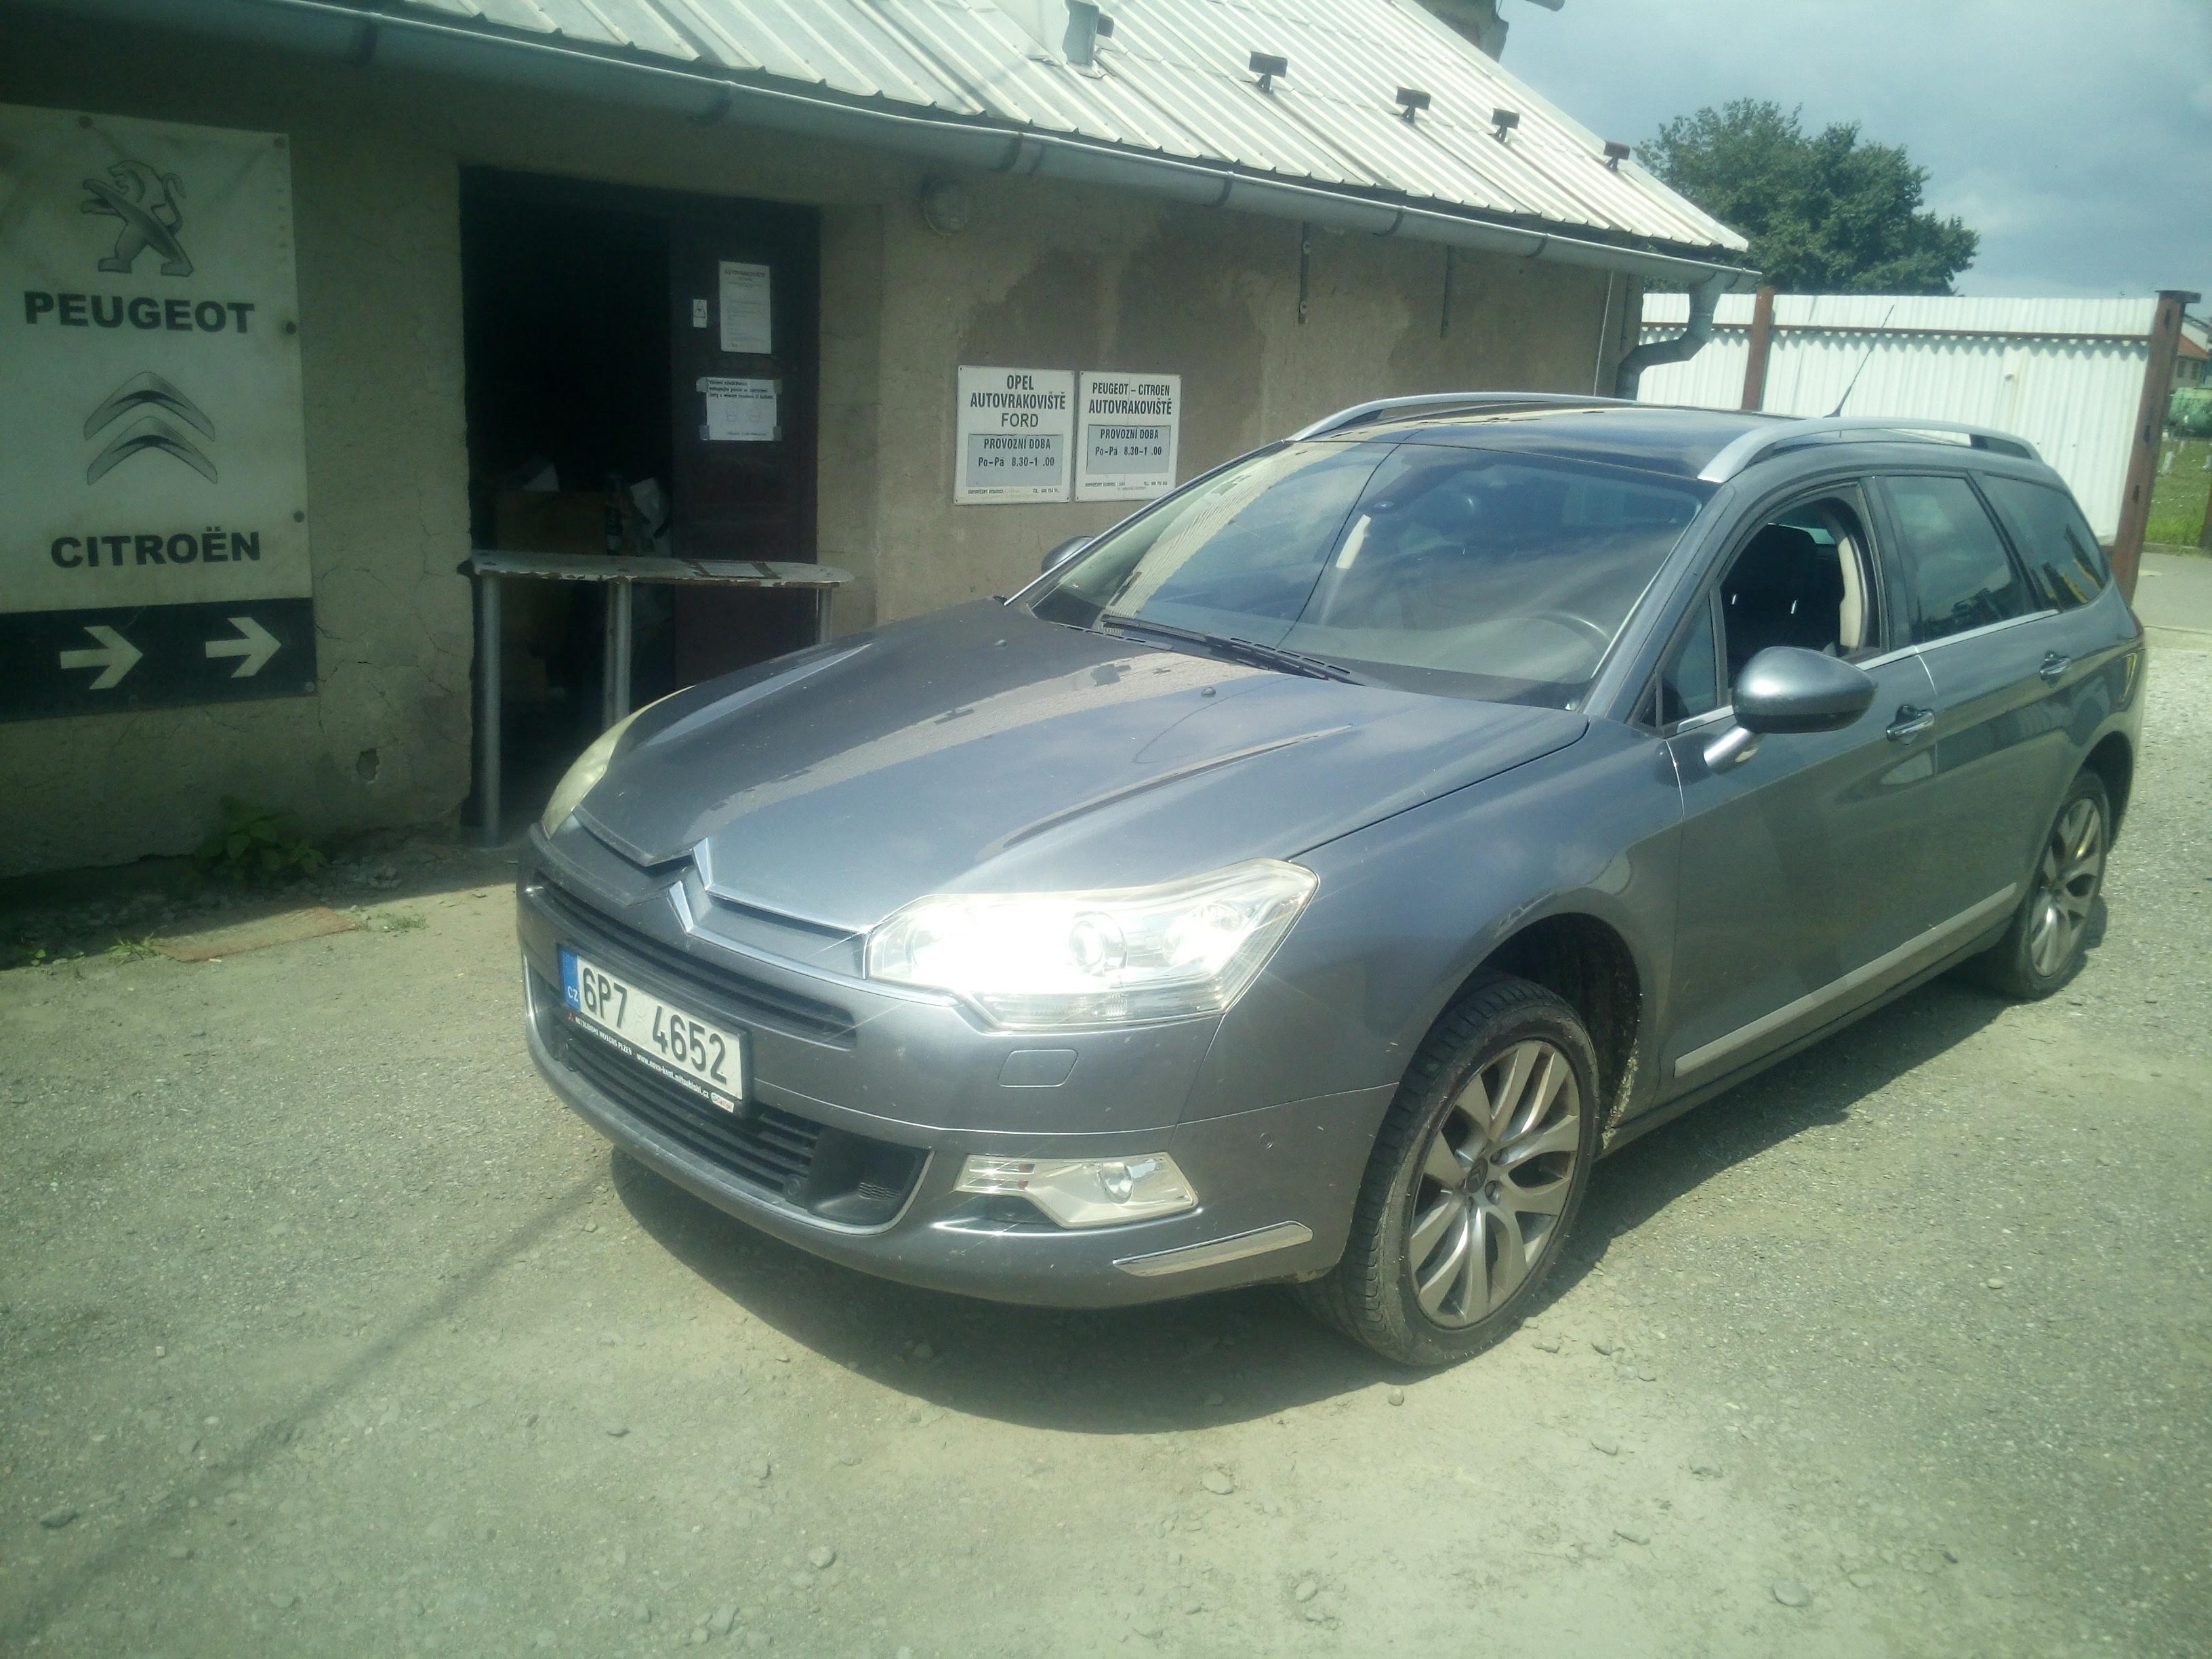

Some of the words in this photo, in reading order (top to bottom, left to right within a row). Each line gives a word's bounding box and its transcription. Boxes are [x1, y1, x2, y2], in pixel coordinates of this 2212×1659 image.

[24, 290, 255, 335] PEUGEOT
[1007, 374, 1034, 391] OPEL
[1092, 382, 1129, 395] PEUGEOT
[970, 391, 1066, 410] AUTOVRAKOVIŠTĚ
[1088, 398, 1172, 415] AUTOVRAKOVIŠTĚ
[1001, 412, 1039, 428] FORD
[1100, 427, 1138, 440] PROVOZNÍ
[1139, 428, 1159, 440] DOBA
[983, 437, 1027, 450] PROVOZNÍ
[1029, 438, 1051, 450] DOBA
[50, 526, 262, 568] CITROËN
[567, 985, 579, 1003] CZ
[582, 966, 628, 1029] 6P7
[652, 1005, 727, 1086] 4652
